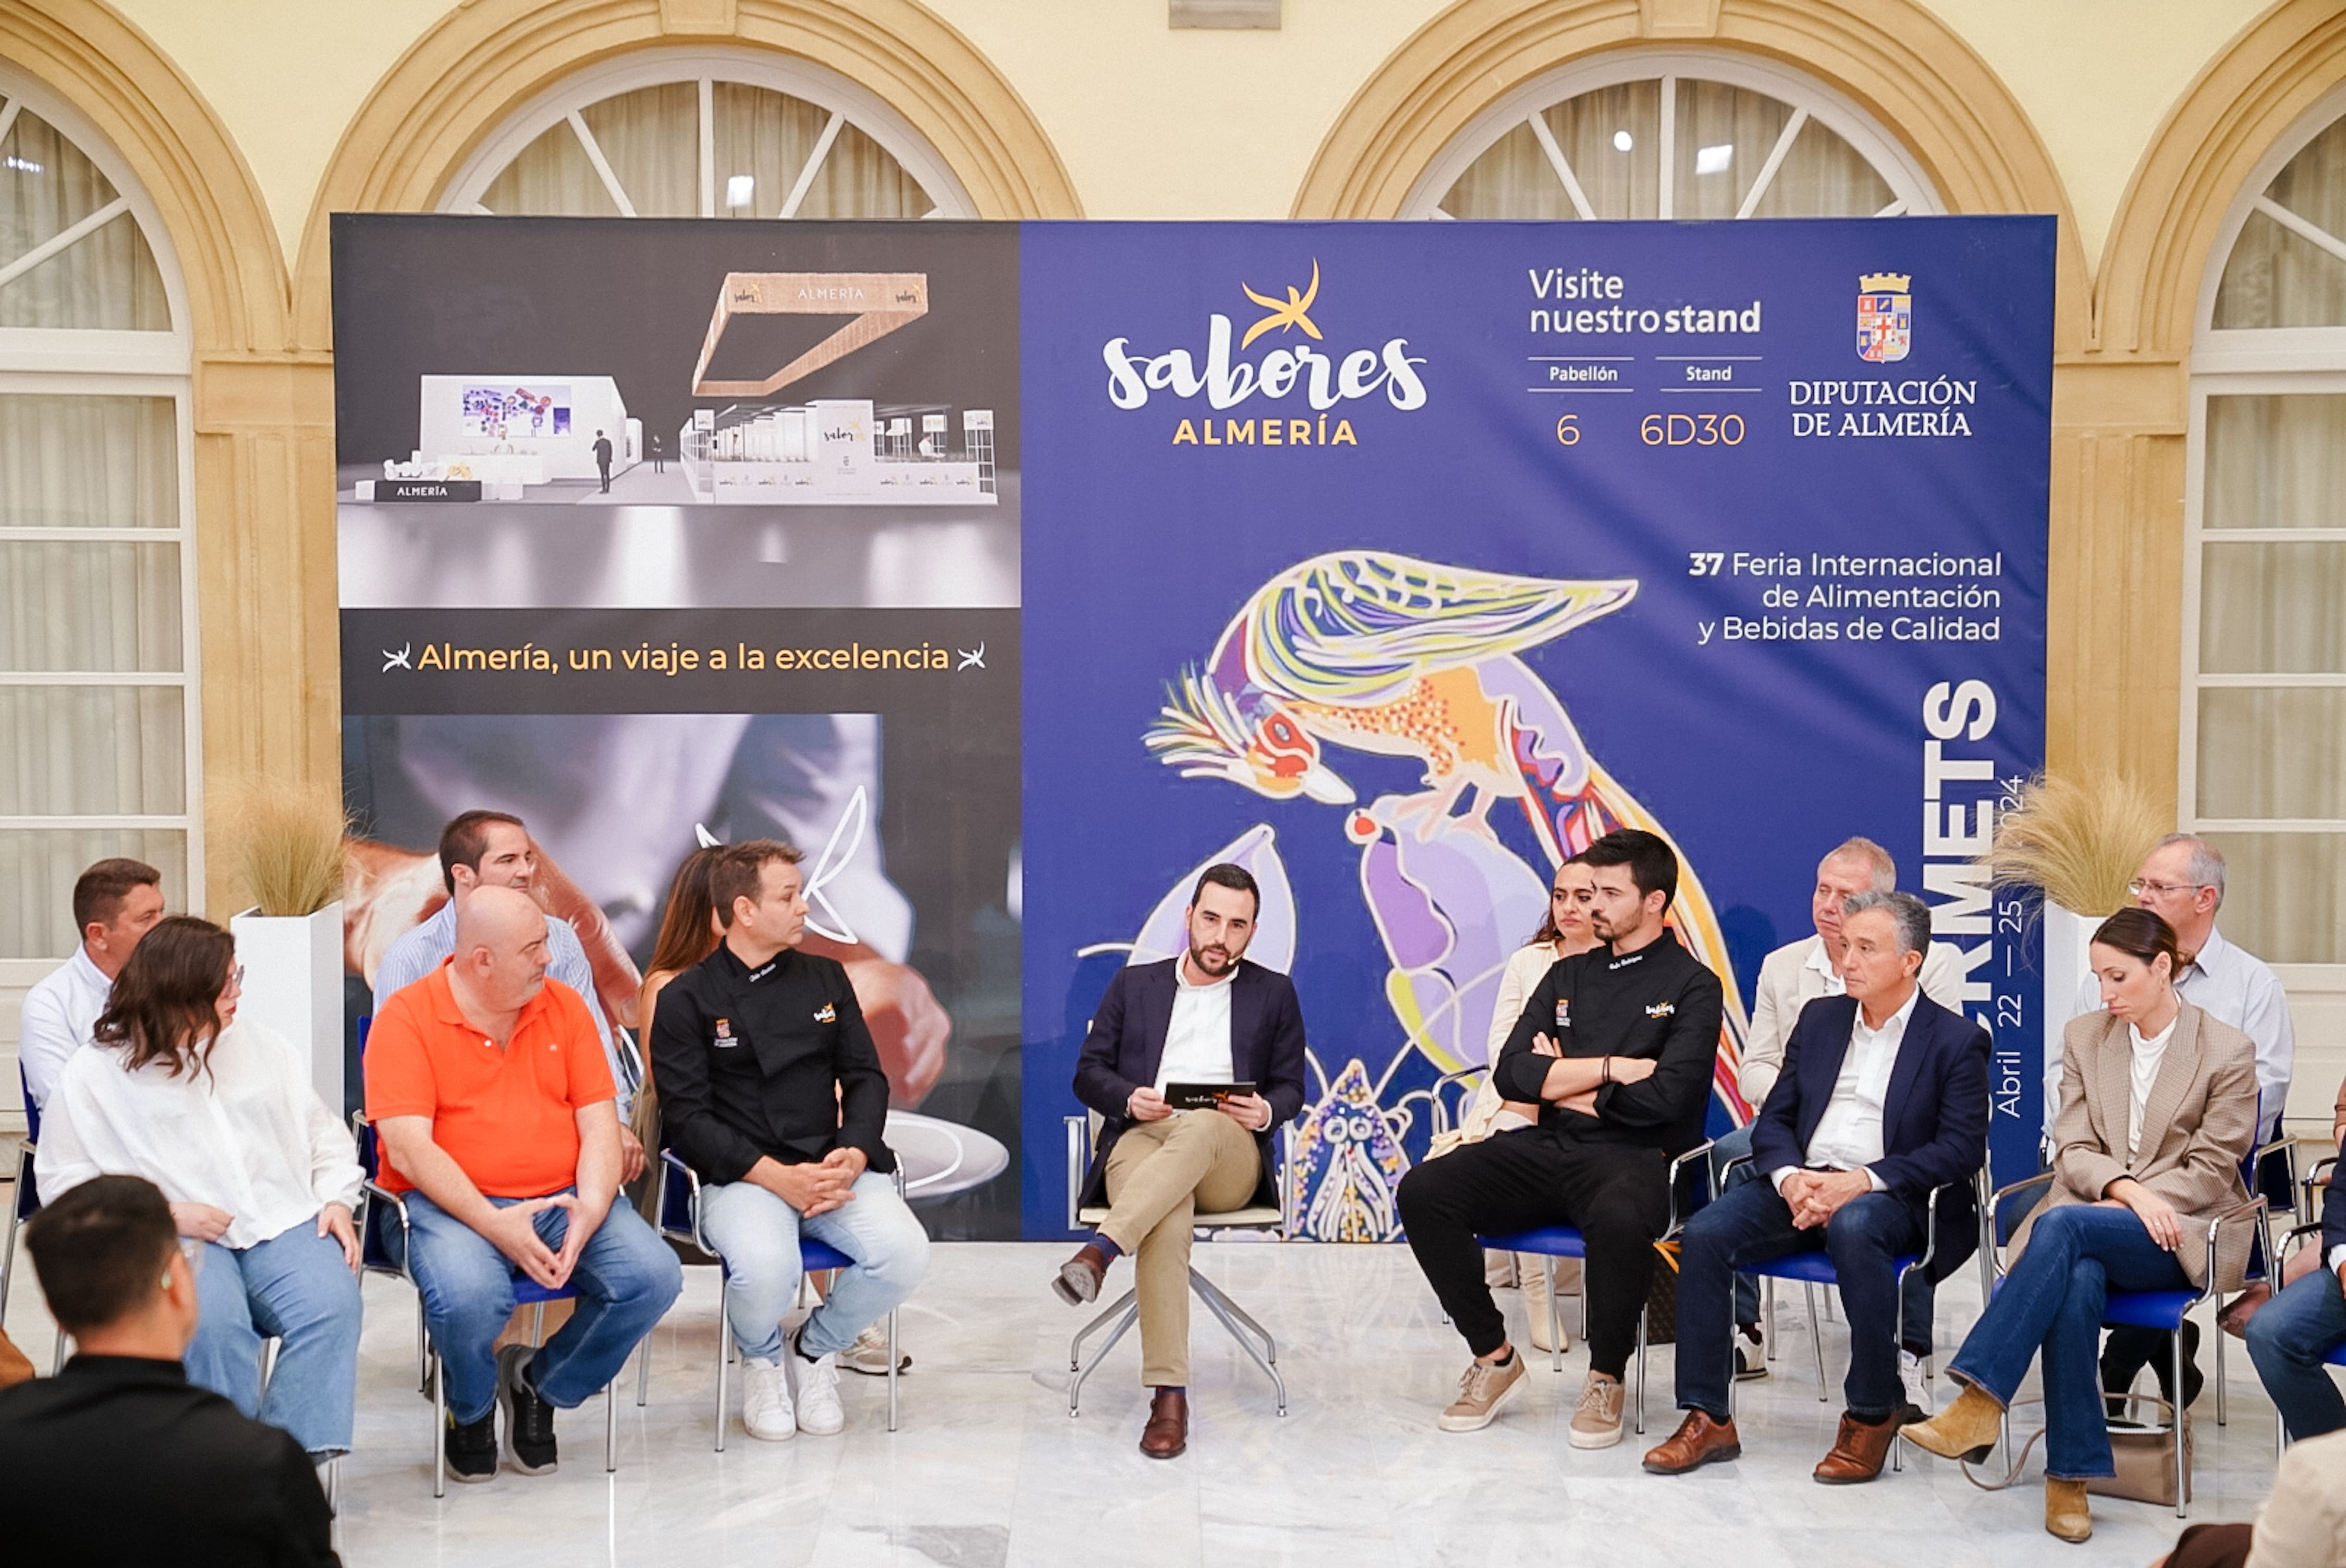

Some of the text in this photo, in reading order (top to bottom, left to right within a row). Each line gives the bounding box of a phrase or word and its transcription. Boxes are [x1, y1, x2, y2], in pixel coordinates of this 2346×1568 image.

[1529, 268, 1623, 299] Visite
[1531, 301, 1761, 333] nuestro stand
[1102, 313, 1428, 411] sabores
[1550, 365, 1618, 381] Pabellón
[1687, 365, 1731, 381] Stand
[1789, 374, 1976, 406] DIPUTACIÓN
[1172, 413, 1358, 445] ALMERÍA
[1557, 414, 1580, 445] 6
[1641, 414, 1744, 445] 6D30
[1792, 406, 1972, 436] DE ALMERÍA
[1689, 552, 2001, 576] 37 Feria Internacional
[1763, 583, 2000, 608] de Alimentación
[1698, 616, 2000, 645] y Bebidas de Calidad
[418, 642, 948, 676] Almería, un viaje a la excelencia
[1998, 901, 2022, 933] 25
[1998, 995, 2021, 1027] 22
[1996, 1052, 2020, 1118] Abril
